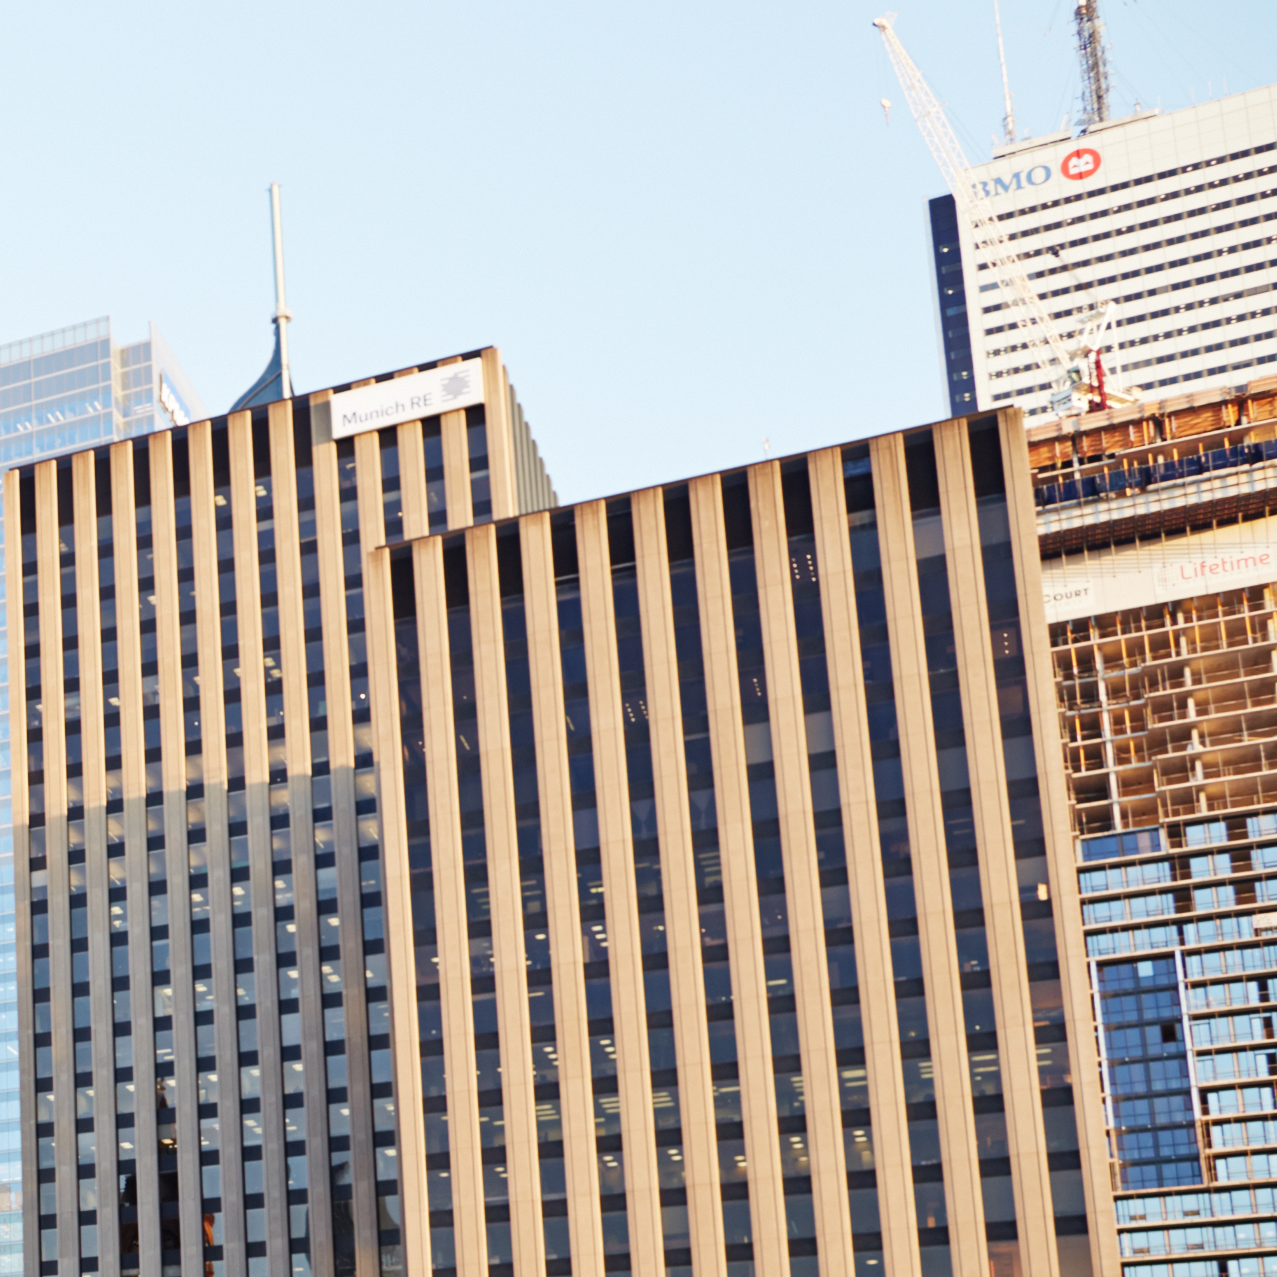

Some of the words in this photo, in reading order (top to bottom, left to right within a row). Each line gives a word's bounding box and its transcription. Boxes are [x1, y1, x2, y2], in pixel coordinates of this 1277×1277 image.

[342, 401, 405, 427] Munich
[410, 392, 434, 410] RE
[1180, 553, 1270, 580] Lifetime
